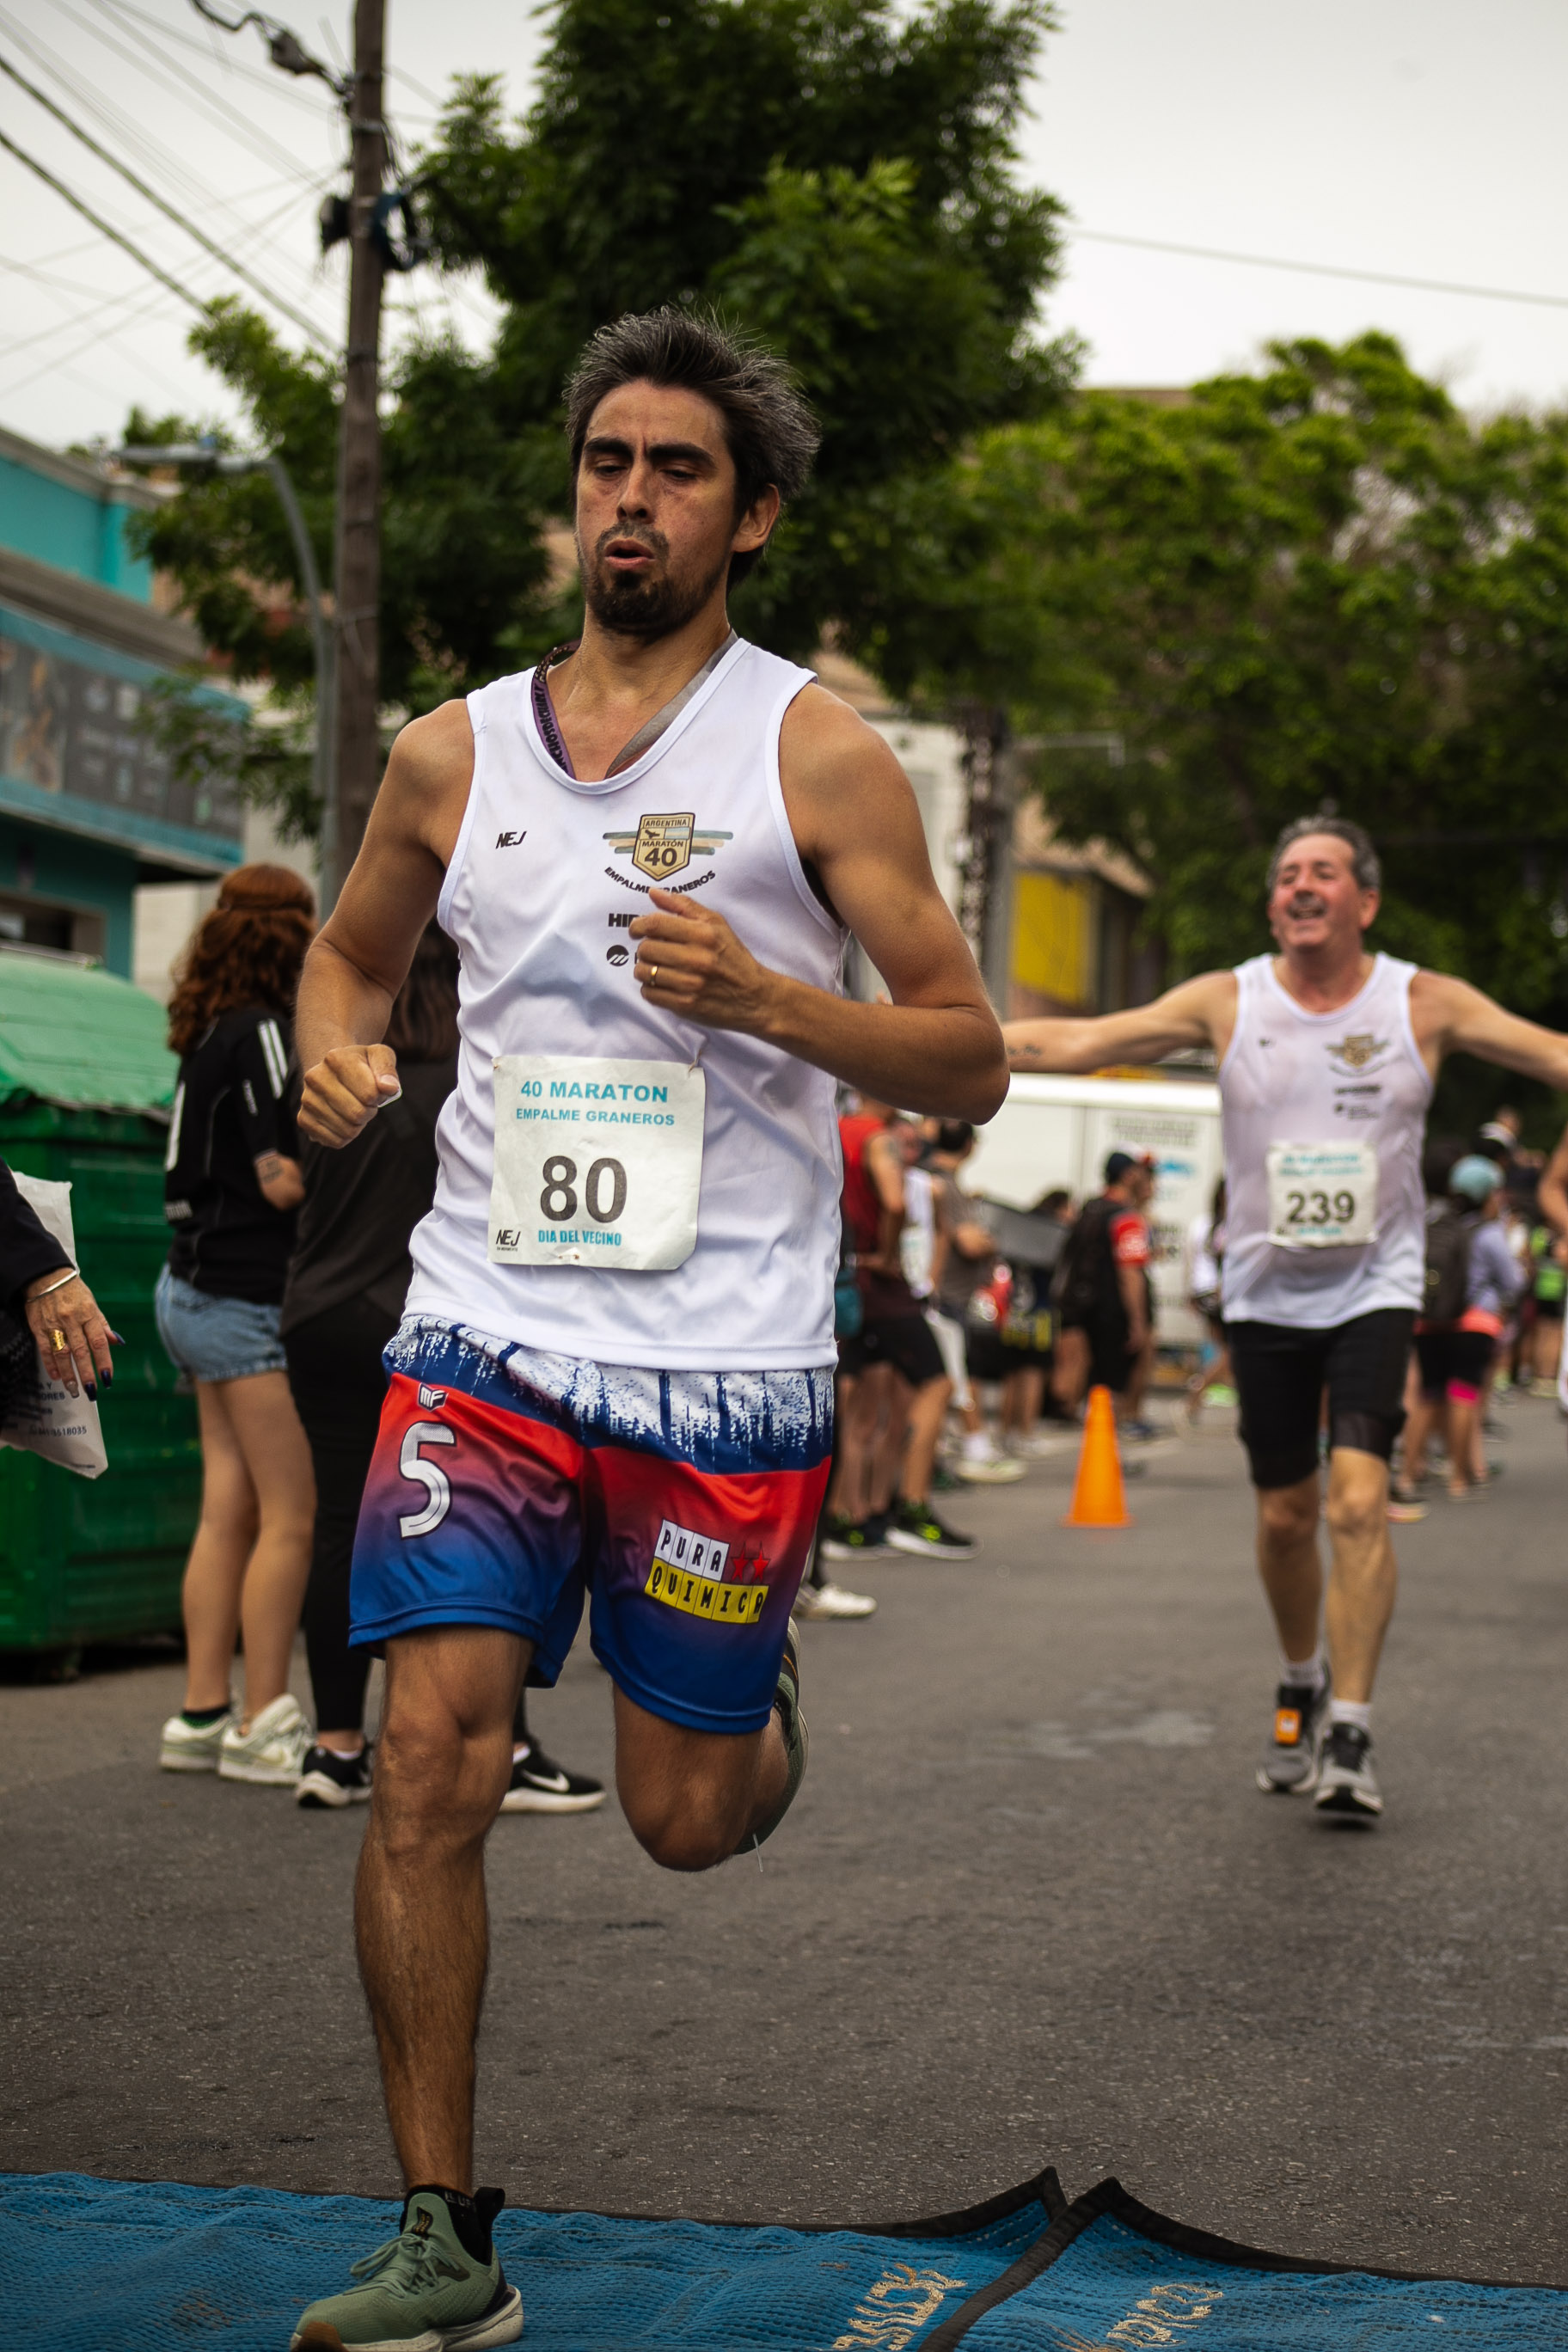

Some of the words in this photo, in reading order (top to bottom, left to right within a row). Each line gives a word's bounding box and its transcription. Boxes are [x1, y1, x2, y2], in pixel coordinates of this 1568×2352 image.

[645, 818, 687, 828] ARGENTINA
[496, 830, 527, 849] NEJ
[642, 839, 684, 848] MARATÓN
[644, 848, 677, 867] 40
[521, 1081, 542, 1098] 40
[549, 1081, 668, 1103] MARATON
[516, 1108, 581, 1121] EMPALME
[585, 1110, 675, 1126] GRANEROS
[540, 1155, 628, 1223] 80
[1287, 1190, 1356, 1224] 239
[496, 1229, 521, 1246] NEJ
[538, 1230, 557, 1243] DIA
[560, 1230, 580, 1243] DEL
[582, 1230, 622, 1246] VECINO
[398, 1420, 457, 1540] 5
[659, 1528, 723, 1572] PURA
[651, 1565, 764, 1615] QUIMICA
